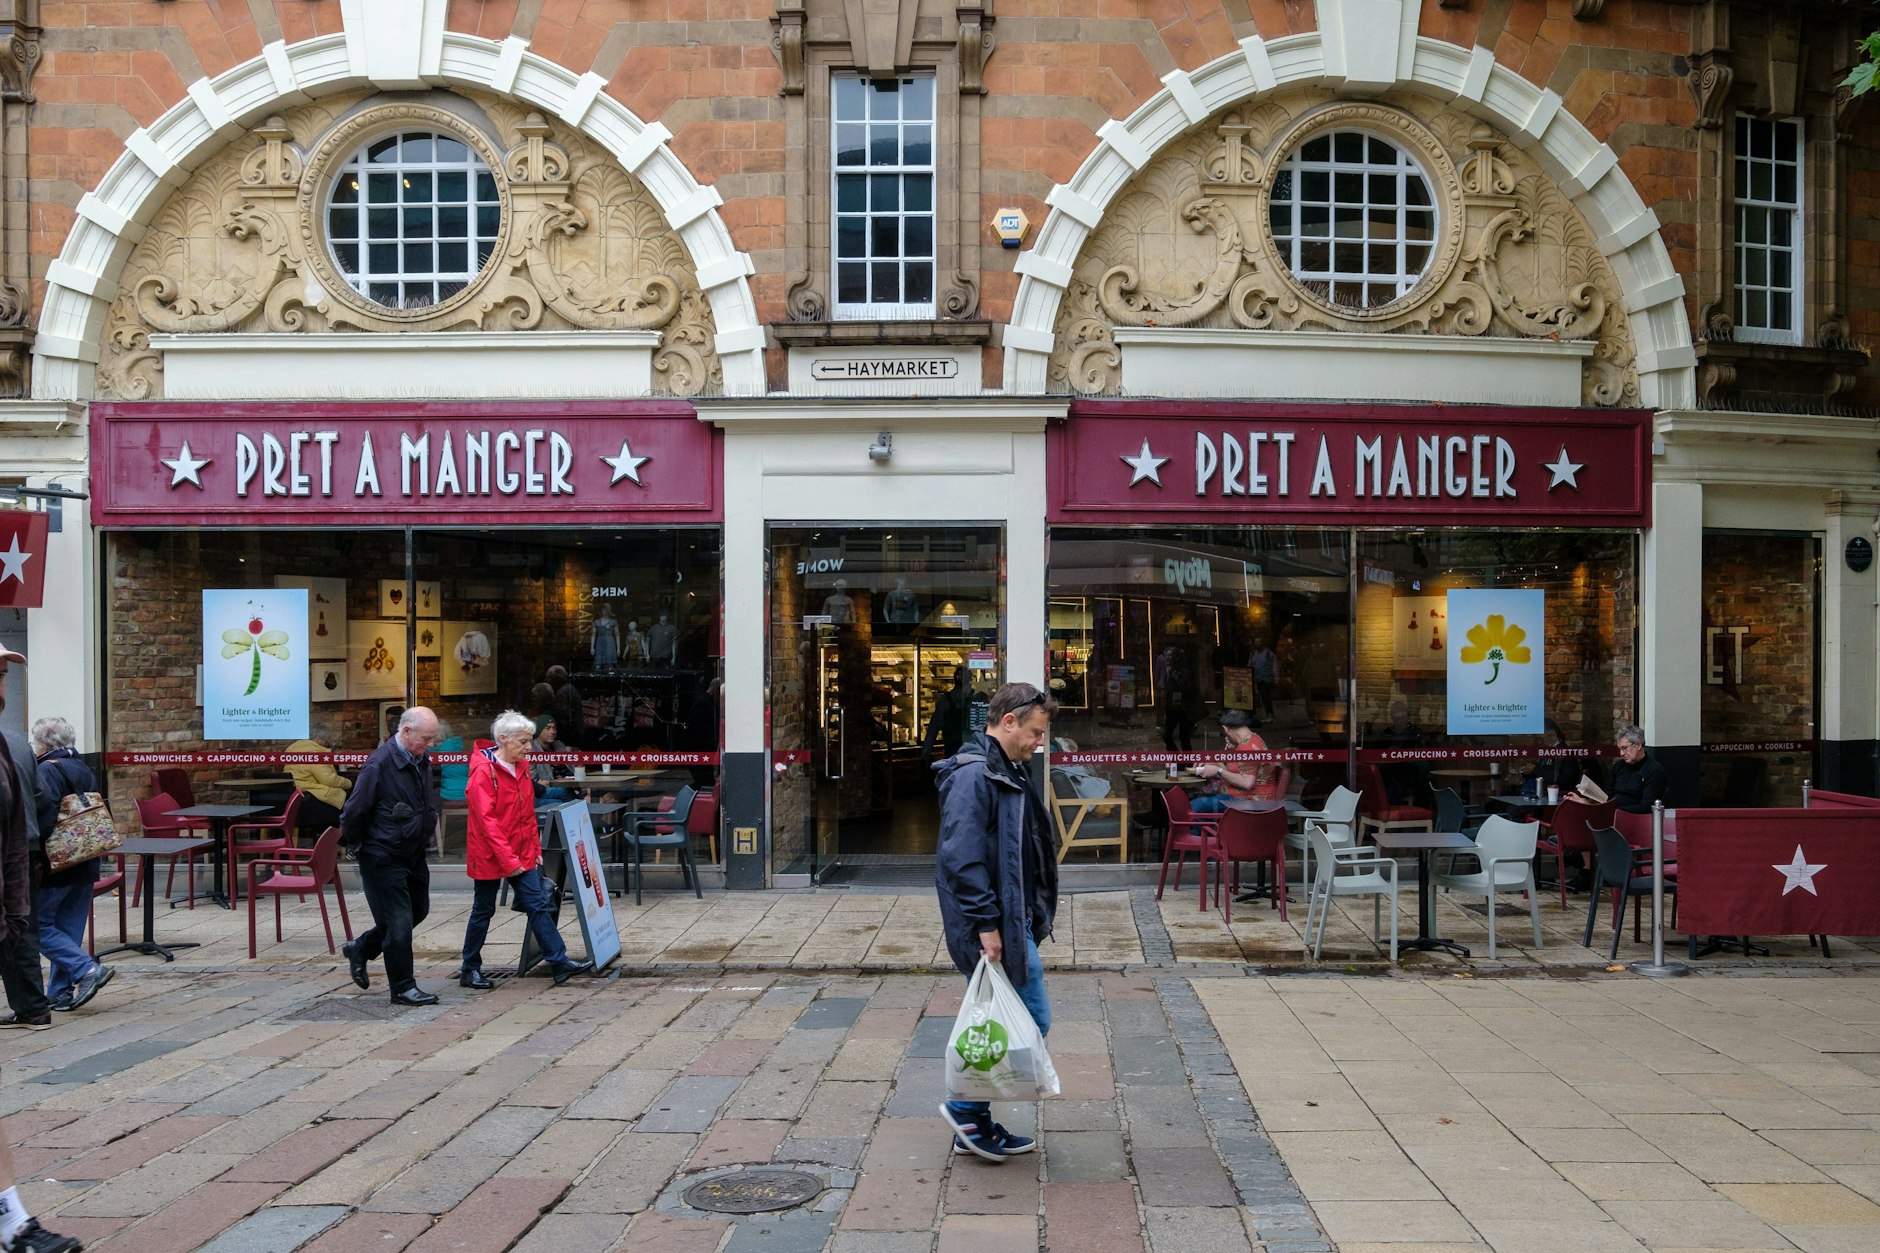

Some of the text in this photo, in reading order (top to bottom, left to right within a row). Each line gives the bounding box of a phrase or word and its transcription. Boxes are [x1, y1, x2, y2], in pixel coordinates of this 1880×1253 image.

[1002, 218, 1019, 228] ADT
[848, 361, 949, 376] HAYMARKET
[236, 429, 575, 497] PRET A MANGER
[1195, 431, 1517, 498] PRET A MANGER
[222, 708, 251, 717] Lighter
[259, 708, 292, 717] Brighter
[1464, 704, 1490, 712] Lighter
[1498, 704, 1528, 712] Brighter
[1710, 742, 1794, 752] CAPPUCCINO COOKIES
[437, 755, 468, 763] SOUPS
[593, 755, 626, 763] MOCHA
[640, 755, 699, 763] CROISSANTS
[1072, 752, 1313, 763] BAGUETTES SANDWICHES CROISSANTS LATTE
[1390, 749, 1589, 759] CAPPUCCINO CROISSANTS BAGUETTES
[737, 831, 753, 852] H
